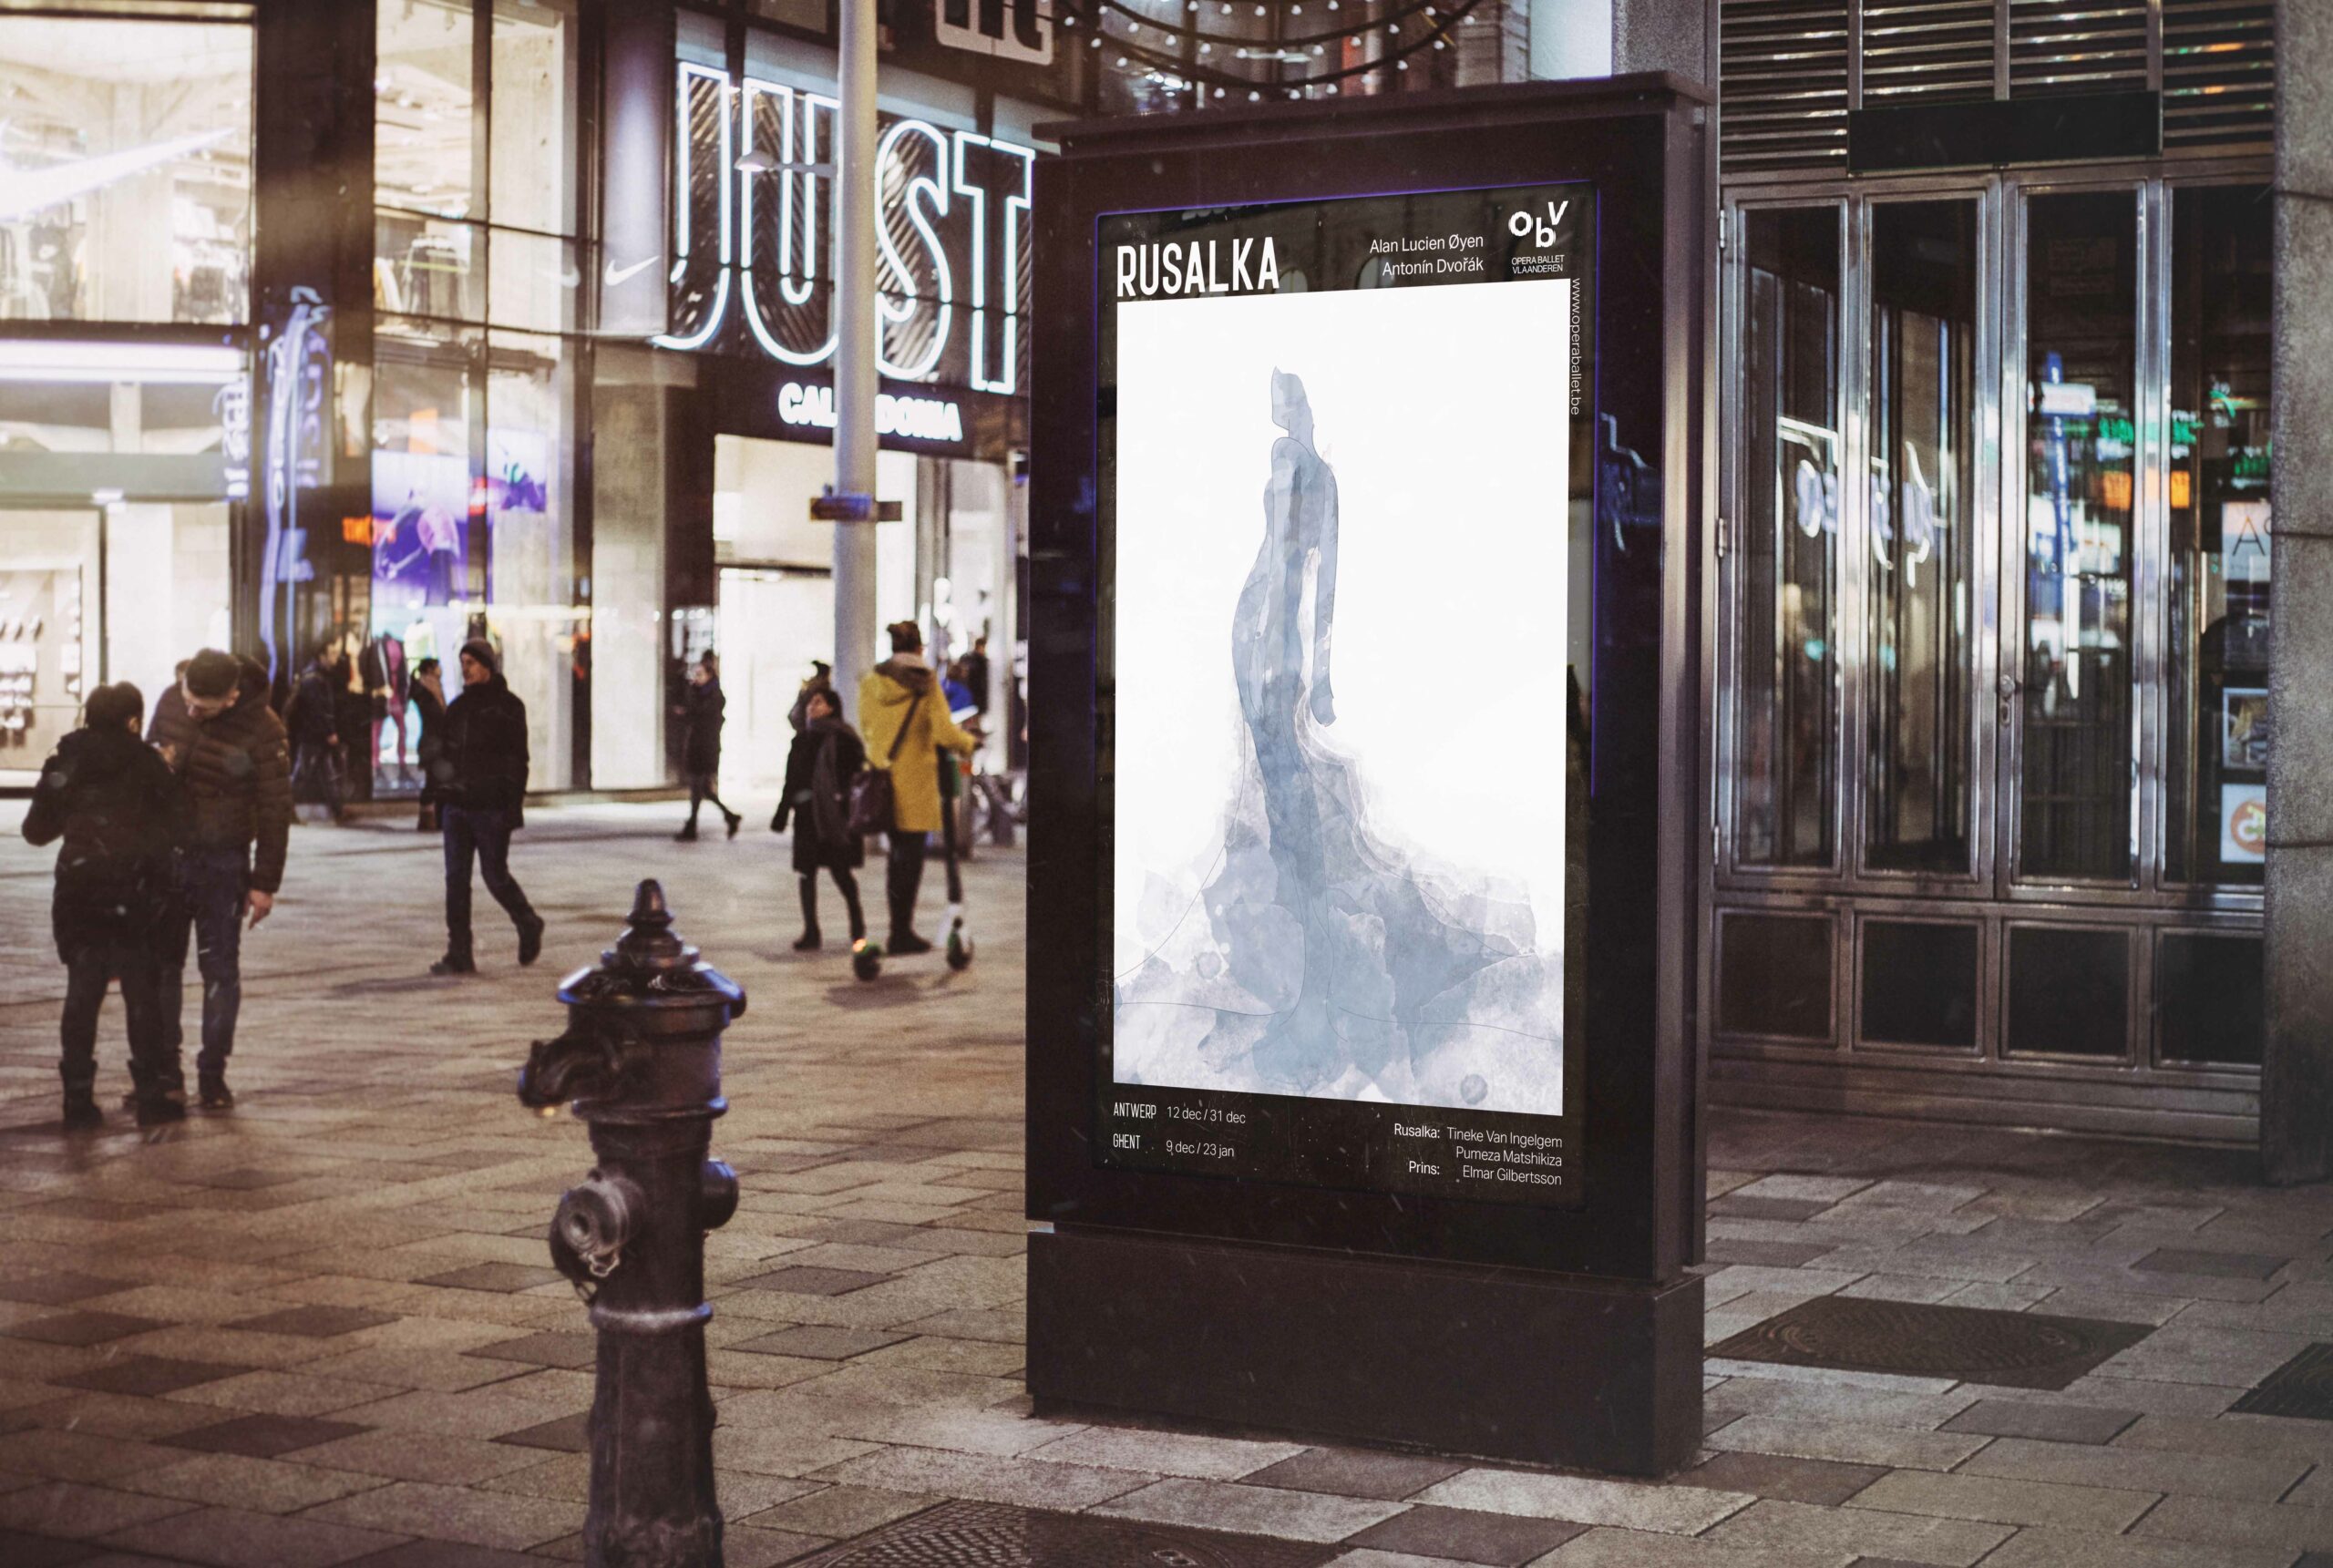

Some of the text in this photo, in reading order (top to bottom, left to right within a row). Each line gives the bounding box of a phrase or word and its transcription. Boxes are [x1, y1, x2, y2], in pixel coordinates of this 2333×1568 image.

[651, 61, 1036, 395] JUST
[1370, 233, 1484, 253] Alan Lucien Øyen
[1117, 237, 1280, 297] RUSALKA
[1382, 256, 1484, 276] Antonín Dvořák
[1511, 254, 1565, 265] OPERA BALLET
[1512, 264, 1564, 274] VLAANDEREN
[1569, 278, 1582, 415] www.operaballet.be
[778, 382, 963, 442] CALDONIA
[1113, 1102, 1156, 1120] ANTWERP
[1166, 1106, 1180, 1119] 12
[1182, 1107, 1202, 1121] dec
[1209, 1109, 1222, 1122] 31
[1226, 1111, 1246, 1123] dec
[1113, 1132, 1141, 1150] GHENT
[1166, 1140, 1173, 1153] 9
[1175, 1141, 1195, 1154] dec
[1203, 1143, 1217, 1155] 23
[1218, 1143, 1235, 1159] jan
[1394, 1122, 1563, 1150] Rusalka: Tineke Van Ingelgem
[1456, 1145, 1562, 1167] Pumeza Matshikiza
[1409, 1161, 1562, 1185] Prins: Elmar Gilbertsson
